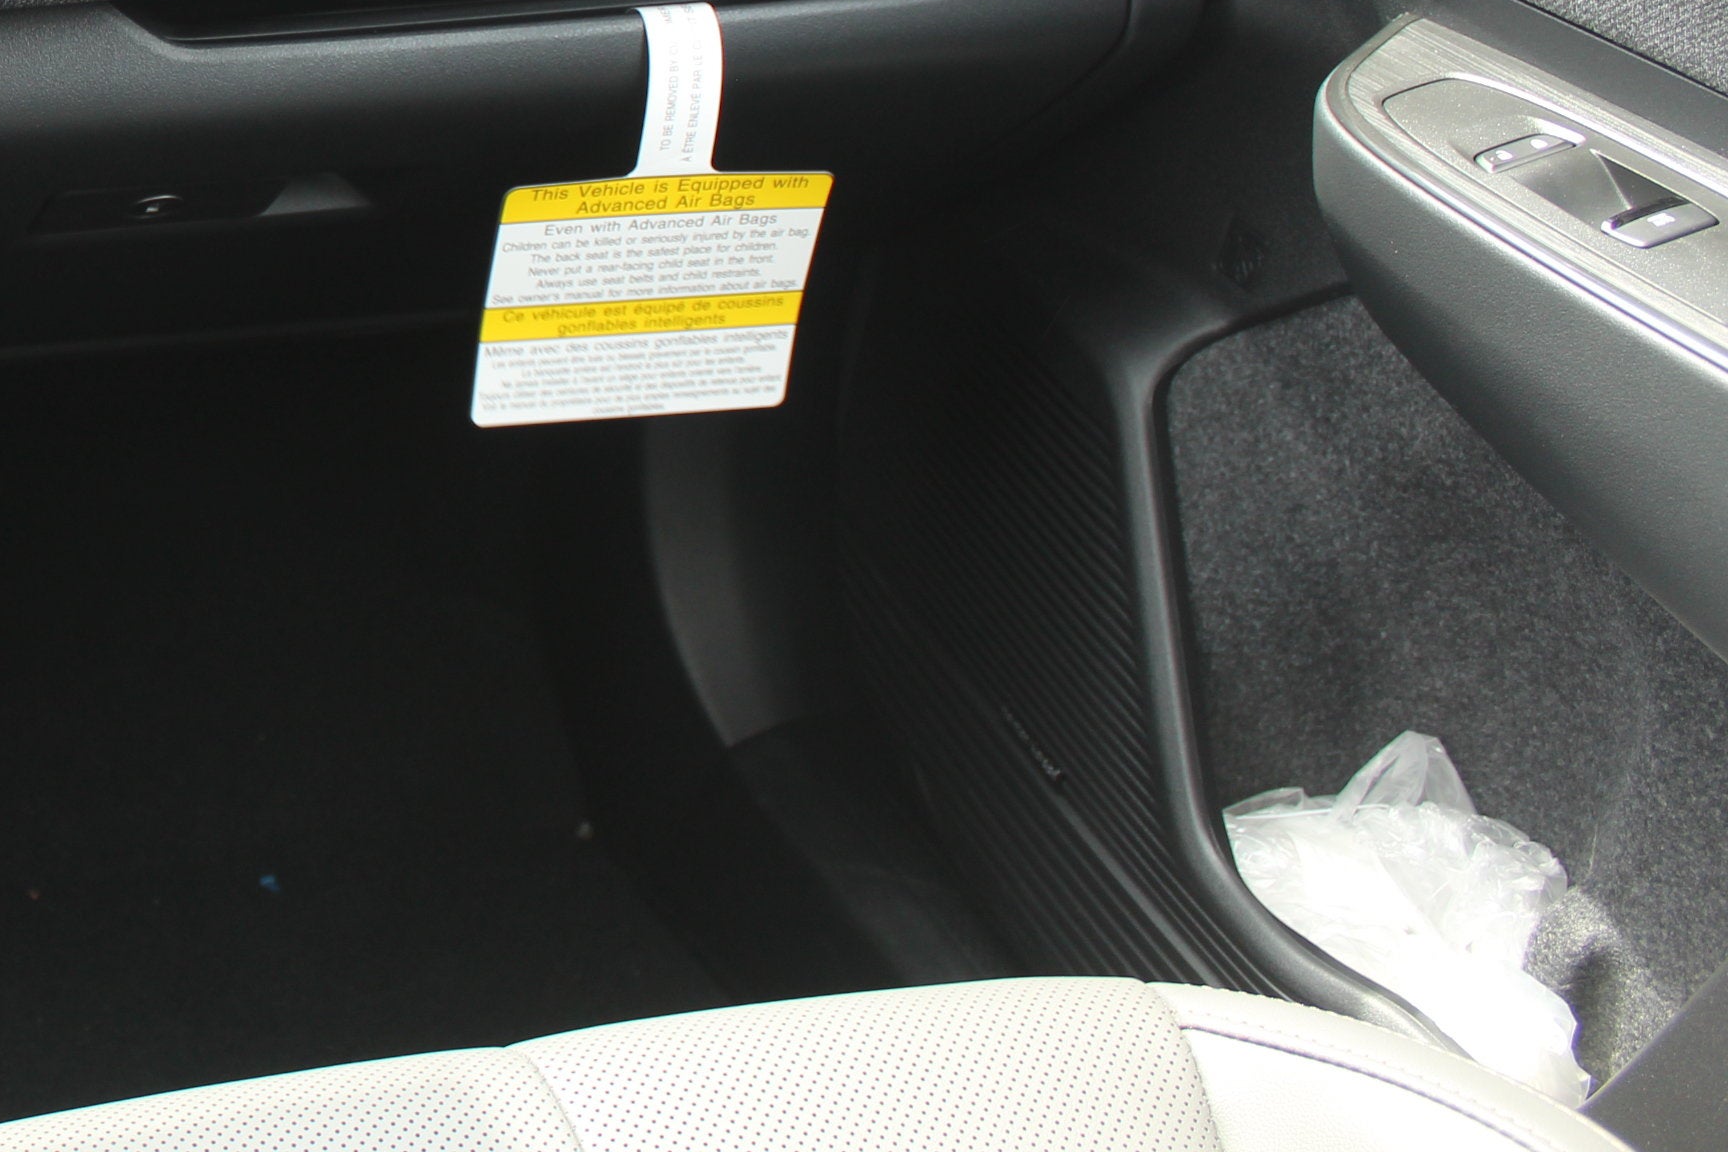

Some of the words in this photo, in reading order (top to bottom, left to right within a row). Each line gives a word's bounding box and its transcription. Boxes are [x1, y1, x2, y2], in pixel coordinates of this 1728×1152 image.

[664, 76, 678, 121] REMOVED
[531, 188, 569, 202] This
[579, 183, 645, 197] Vehicle
[653, 180, 669, 192] is
[677, 175, 765, 194] Equipped
[772, 177, 810, 189] with
[576, 197, 667, 214] Advanced
[676, 195, 702, 208] Air
[709, 192, 756, 210] Bags
[544, 223, 584, 235] Even
[590, 221, 621, 233] with
[628, 216, 705, 231] Advanced
[712, 215, 733, 226] Air
[738, 212, 778, 227] Bags
[502, 242, 547, 252] Children
[552, 241, 571, 249] can
[575, 238, 590, 248] be
[595, 237, 621, 247] killed
[641, 234, 688, 246] seriously
[692, 231, 728, 242] injured
[731, 229, 745, 240] by
[749, 228, 767, 238] the
[770, 227, 784, 237] air
[502, 310, 525, 322] Ce
[532, 306, 596, 320] véhicule
[604, 304, 627, 316] est
[633, 300, 686, 316] équipé
[691, 299, 711, 311] de
[718, 294, 785, 309] coussins
[556, 319, 637, 337] gonflables
[643, 314, 726, 332] intelligents
